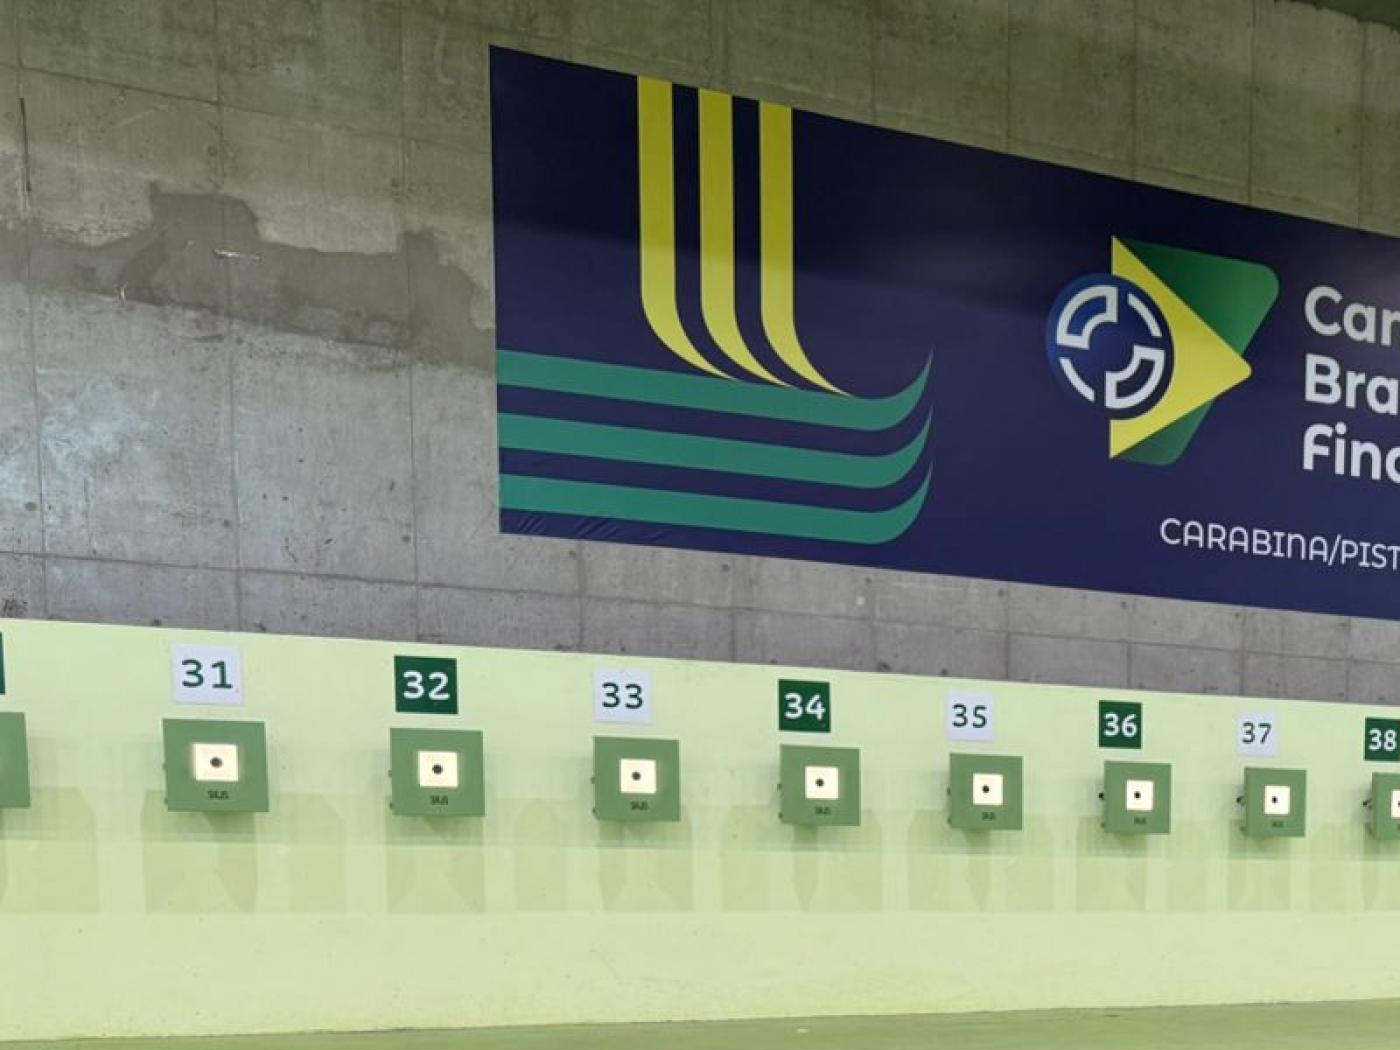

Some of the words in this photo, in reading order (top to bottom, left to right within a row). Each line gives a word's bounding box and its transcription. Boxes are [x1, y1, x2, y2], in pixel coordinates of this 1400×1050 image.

[181, 658, 233, 690] 31
[403, 670, 450, 701] 32
[602, 682, 643, 710] 33
[784, 692, 826, 720] 34
[952, 704, 988, 729] 35
[1104, 713, 1137, 738] 36
[1242, 721, 1272, 745] 37
[1368, 729, 1397, 752] 38
